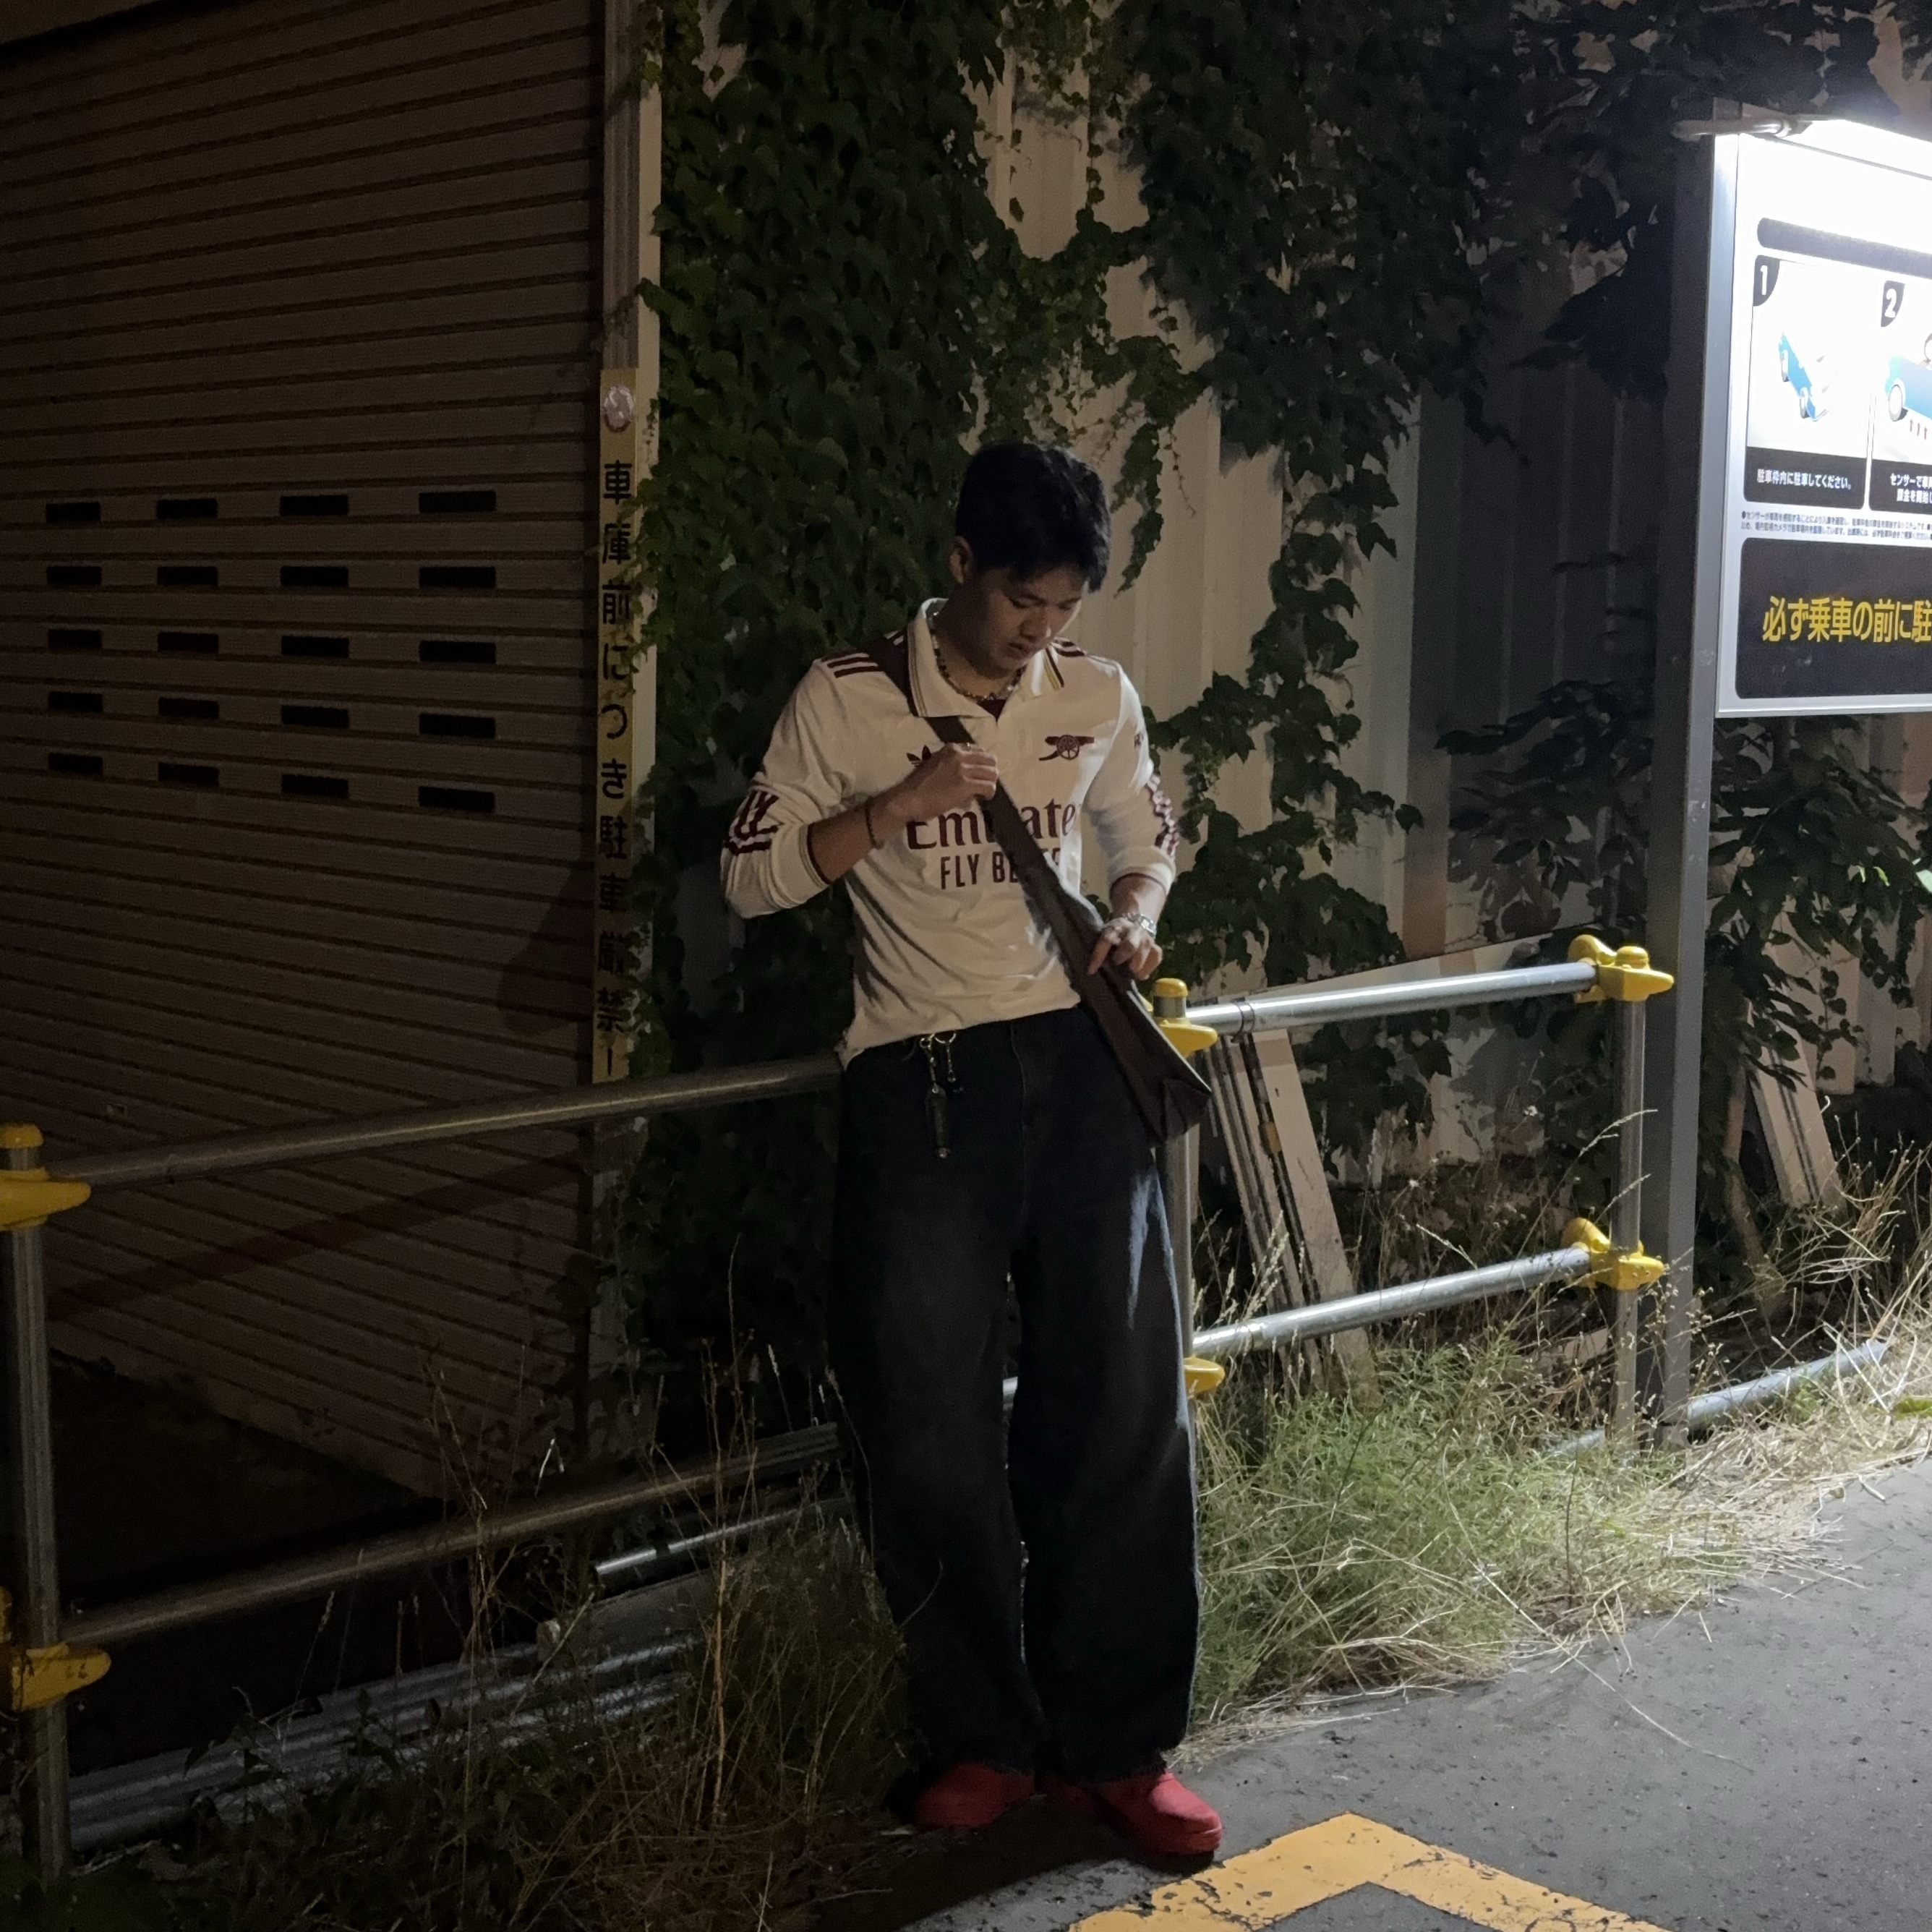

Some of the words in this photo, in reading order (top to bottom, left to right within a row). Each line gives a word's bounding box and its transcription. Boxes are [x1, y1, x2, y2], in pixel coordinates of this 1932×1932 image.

[1760, 265, 1768, 296] 1
[1884, 288, 1897, 318] 2
[941, 853, 980, 890] FLY
